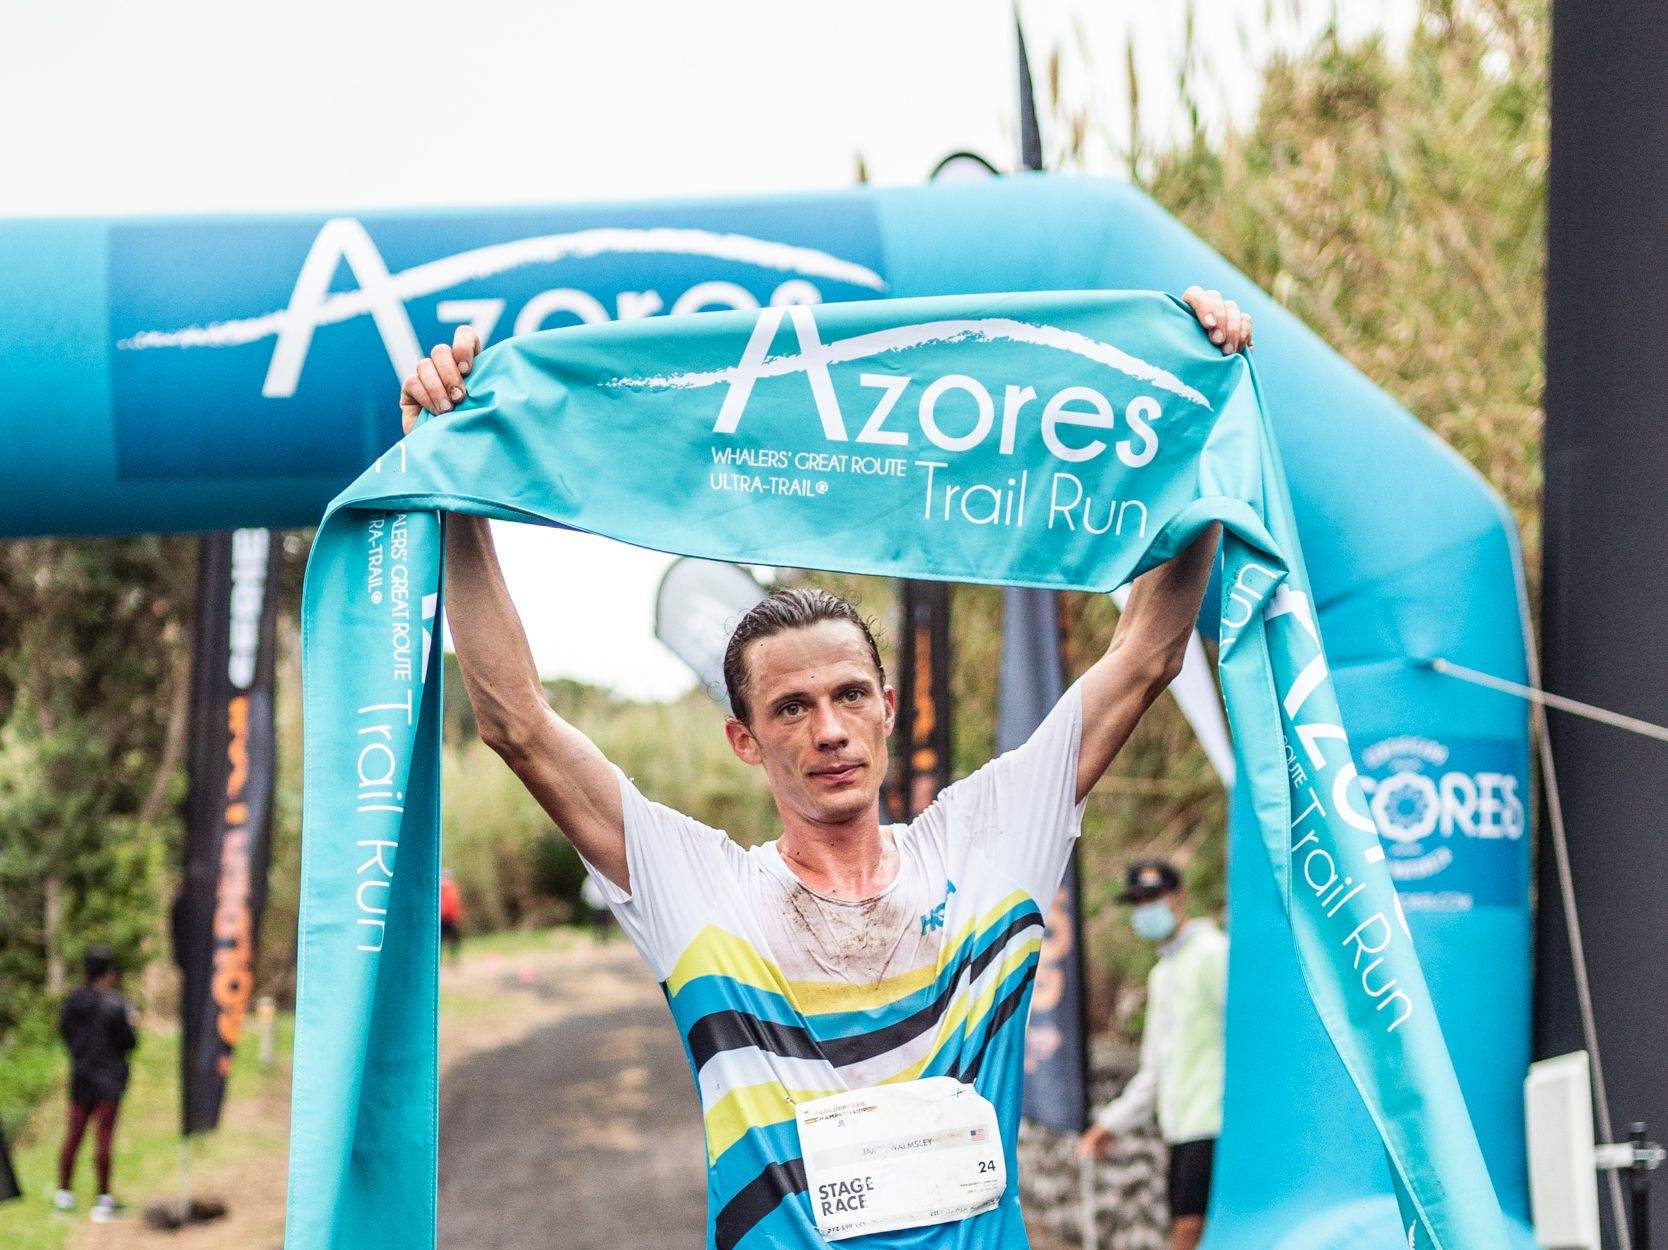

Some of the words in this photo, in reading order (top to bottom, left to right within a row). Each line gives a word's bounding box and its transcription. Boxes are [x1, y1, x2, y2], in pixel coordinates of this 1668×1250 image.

[712, 304, 1162, 468] Azores
[795, 452, 849, 473] GREAT
[852, 456, 907, 477] ROUTE
[914, 461, 1027, 528] Trail
[1047, 471, 1147, 539] Run
[391, 564, 410, 619] GREAT
[1220, 563, 1278, 645] un
[392, 623, 412, 681] ROUTE
[357, 688, 412, 813] Trail
[1290, 786, 1367, 918] Trail
[1342, 912, 1413, 1033] Run
[818, 1176, 875, 1201] STAGE
[978, 1160, 996, 1174] 24
[821, 1194, 868, 1217] RACE
